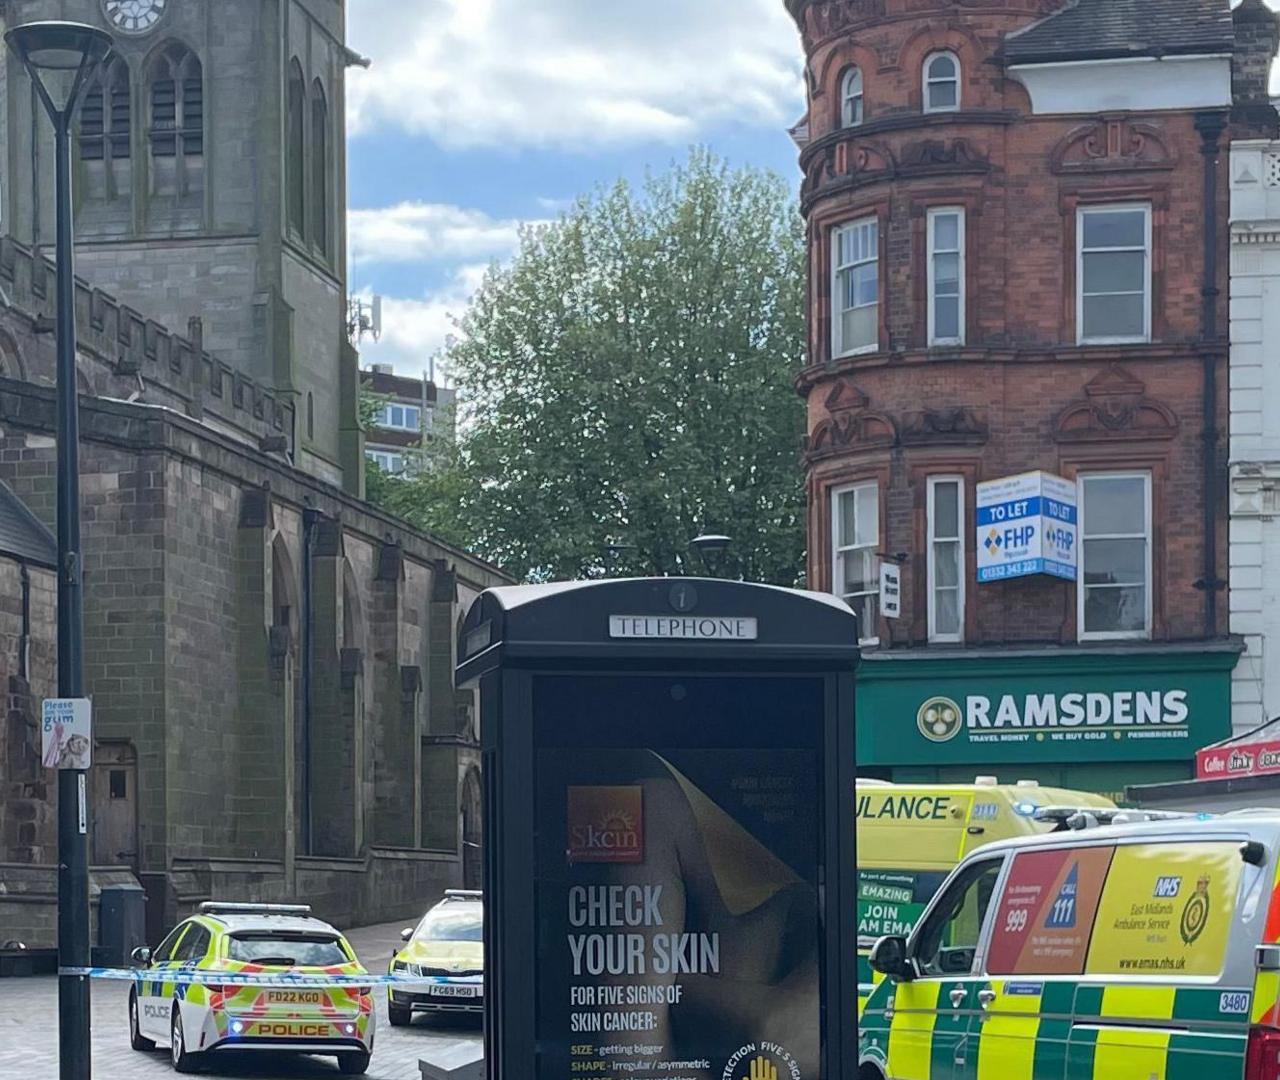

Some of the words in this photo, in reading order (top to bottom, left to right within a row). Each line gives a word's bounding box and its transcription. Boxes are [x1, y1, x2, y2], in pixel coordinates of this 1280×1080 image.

[990, 505, 1006, 521] TO
[1008, 501, 1029, 518] LET
[1049, 501, 1058, 515] TO
[1058, 504, 1070, 519] LET
[1004, 525, 1035, 550] FHP
[1056, 527, 1074, 551] FHP
[617, 618, 747, 637] TELEPHONE
[966, 690, 1189, 728] RAMSDENS
[44, 715, 74, 732] gum
[1084, 732, 1107, 740] GOLD
[572, 825, 639, 848] Skcin
[862, 886, 911, 902] EMAZING
[1155, 877, 1181, 896] NHS
[568, 884, 664, 927] CHECK
[864, 904, 898, 919] JOIN
[1052, 898, 1074, 924] 111
[1004, 909, 1028, 932] 999
[568, 933, 646, 976] YOUR
[652, 932, 721, 974] SKIN
[268, 991, 297, 1002] FD22
[570, 985, 595, 1006] FOR
[597, 985, 624, 1005] FIVE
[626, 984, 664, 1005] SIGNS
[666, 984, 683, 1004] OF
[1221, 993, 1248, 1011] 3480
[144, 1004, 170, 1019] POLICE
[257, 1024, 330, 1037] POLICE
[570, 1012, 602, 1032] SKIN
[603, 1011, 658, 1031] CANCER:
[570, 1045, 593, 1055] SIZE
[599, 1045, 633, 1057] getting
[634, 1043, 664, 1055] bigger
[761, 1041, 783, 1056] FIVE
[571, 1061, 606, 1071] SHAPE
[657, 1059, 711, 1071] asymmetric
